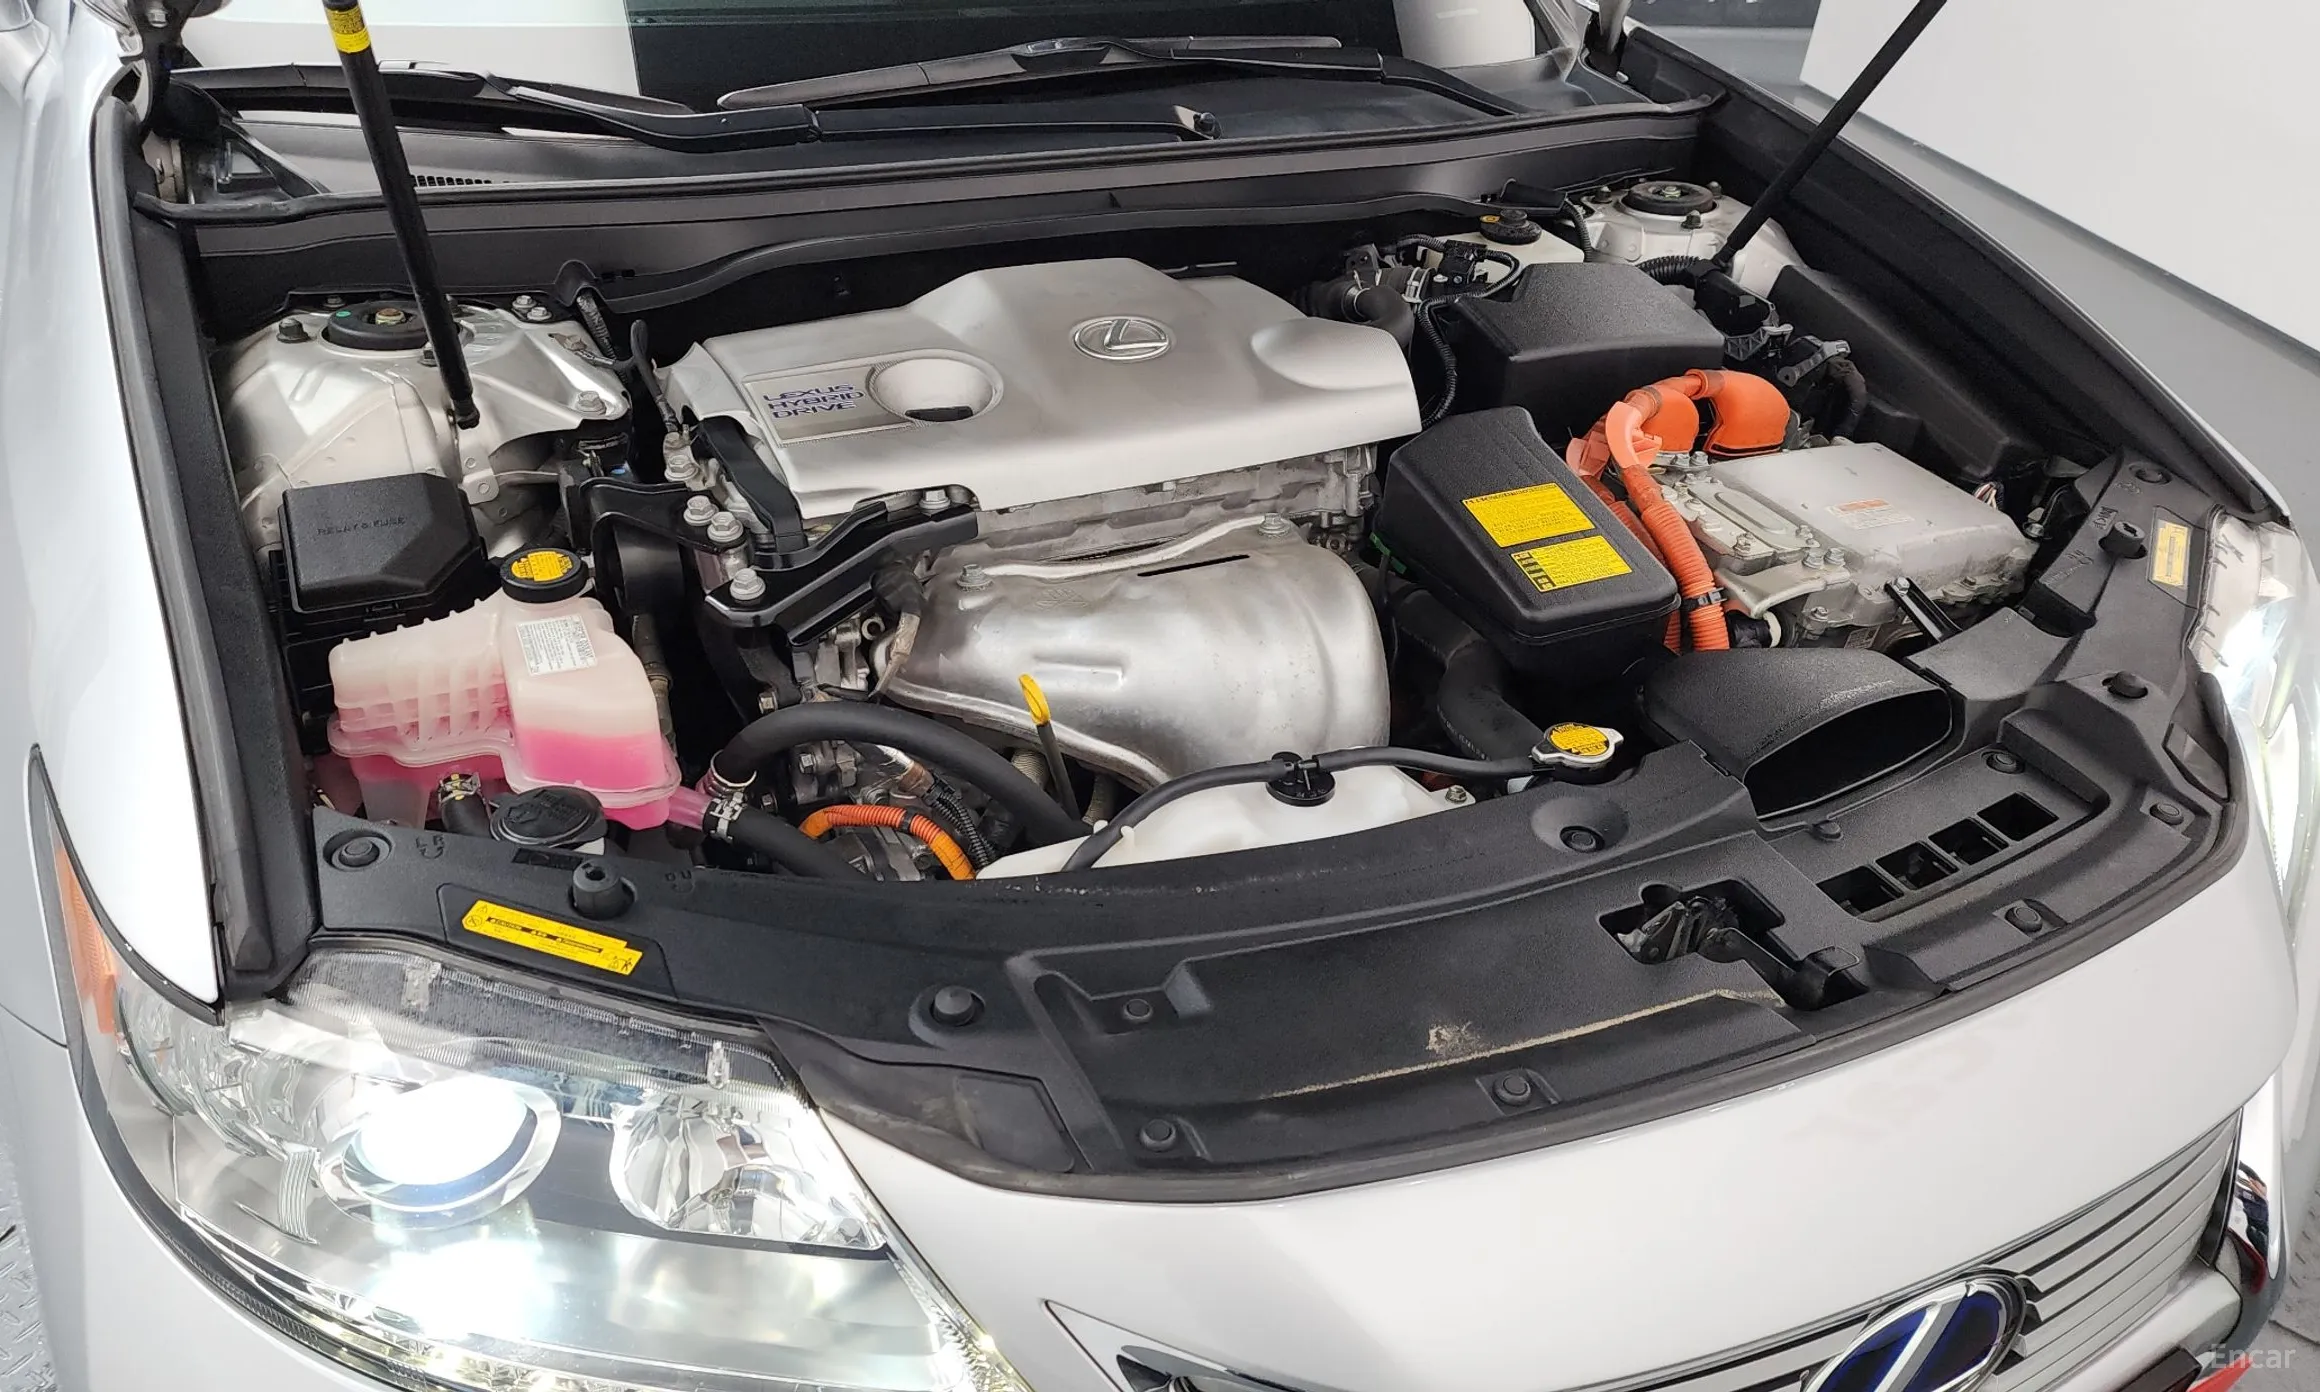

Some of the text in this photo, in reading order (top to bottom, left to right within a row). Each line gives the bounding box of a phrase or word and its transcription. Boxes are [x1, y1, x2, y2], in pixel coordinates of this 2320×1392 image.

[763, 384, 854, 401] LEXUS
[768, 392, 864, 409] HYBRID
[773, 403, 857, 418] DRIVE
